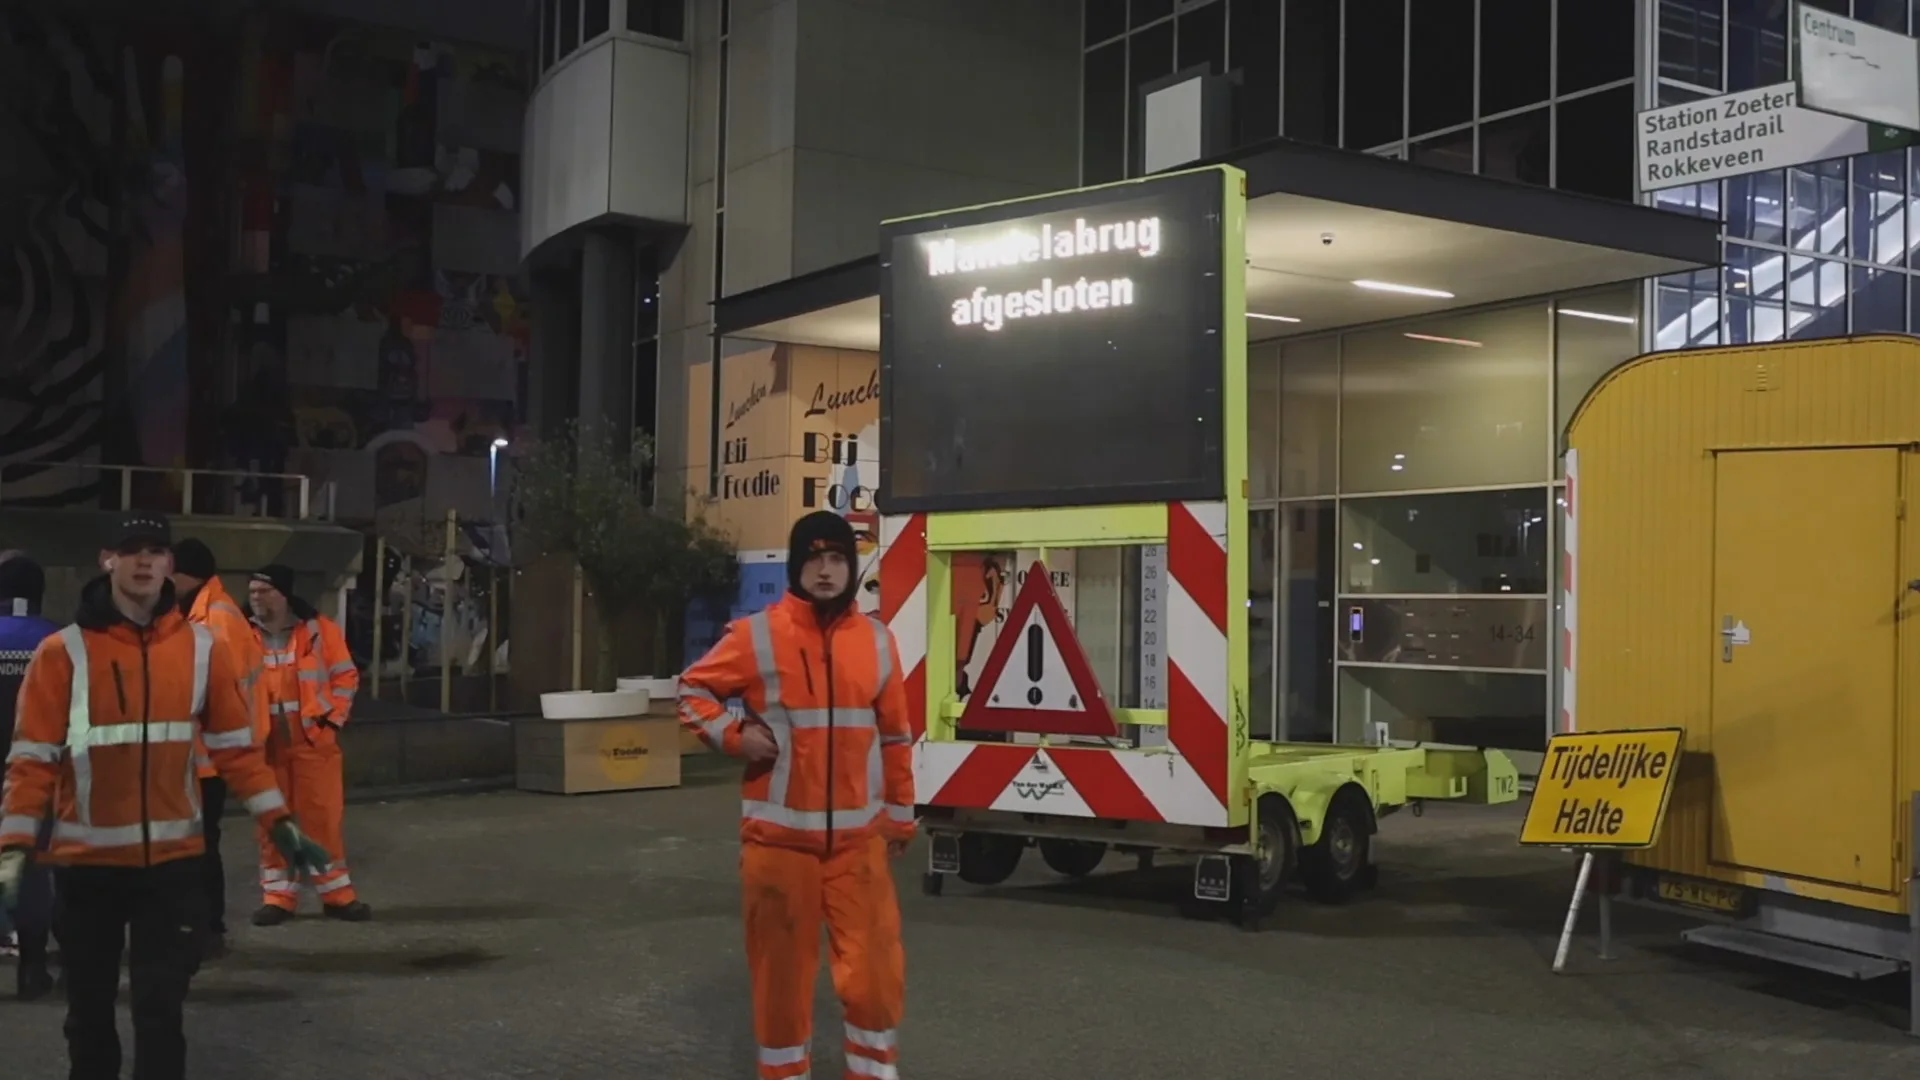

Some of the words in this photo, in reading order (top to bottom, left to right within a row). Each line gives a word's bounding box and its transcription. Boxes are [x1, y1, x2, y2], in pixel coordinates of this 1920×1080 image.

[1804, 13, 1856, 47] Centrum
[1645, 107, 1717, 134] Station
[1724, 91, 1795, 119] Zoeter
[1646, 114, 1784, 158] Randstadrail
[1648, 148, 1764, 181] Rokkeveen
[928, 216, 1160, 276] Mandelabrug
[952, 276, 1134, 331] afgesloten
[803, 432, 859, 467] Bij
[723, 470, 781, 500] Foodie
[1144, 566, 1157, 579] 26
[1144, 588, 1157, 601] 24
[1144, 609, 1157, 623] 22
[1144, 631, 1157, 645] 20
[1489, 624, 1536, 643] 14-34
[1144, 654, 1157, 667] 18
[1144, 676, 1157, 689] 16
[1550, 744, 1667, 789] Tijdelijke
[1553, 799, 1624, 836] Halte
